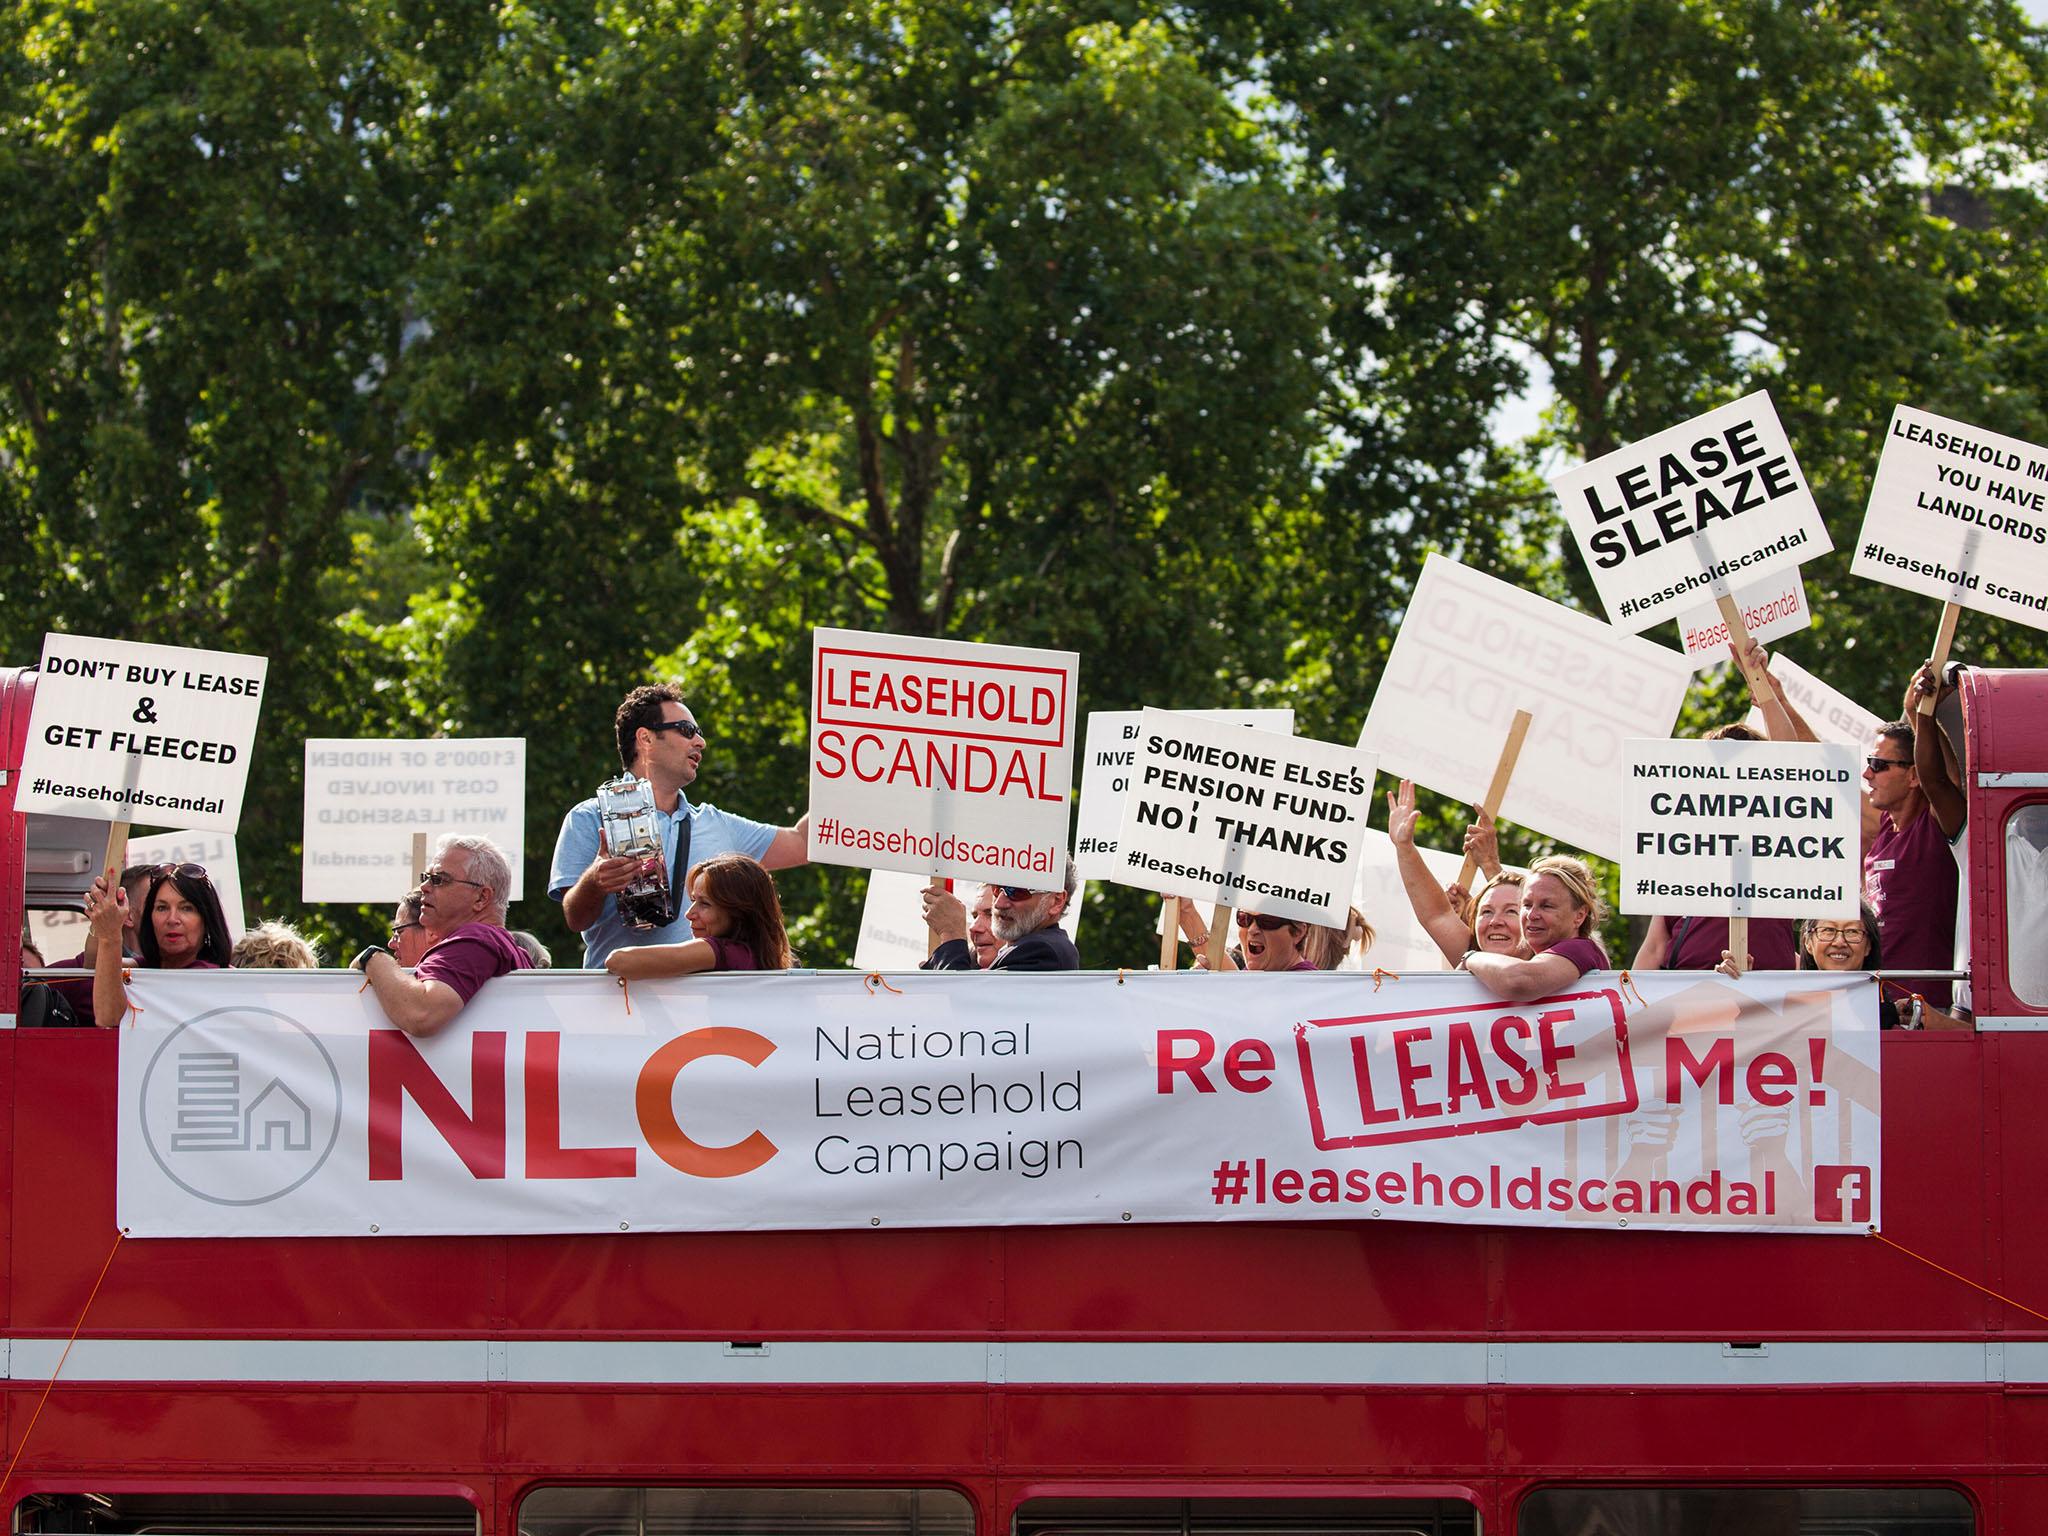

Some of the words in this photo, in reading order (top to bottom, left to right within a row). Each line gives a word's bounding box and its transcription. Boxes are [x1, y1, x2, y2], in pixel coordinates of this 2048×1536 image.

[1894, 420, 2020, 471] LEASEHOLD
[1584, 420, 1766, 524] LEASE
[1938, 465, 1981, 491] YOU
[1987, 481, 2045, 511] HAVE
[1590, 456, 1798, 568] SLEAZE
[1918, 492, 2047, 543] LANDLORDS
[1620, 528, 1807, 617] #leaseholdscandal
[1864, 544, 1979, 590] #leasehold
[1985, 583, 2048, 611] scand
[1687, 586, 1800, 654] #leaseldscandal
[126, 666, 176, 686] BUY
[183, 672, 259, 696] LEASE
[828, 668, 1055, 725] LEASEHOLD
[133, 697, 157, 724] &
[45, 725, 102, 748] GET
[110, 732, 236, 764] FLEECED
[816, 730, 1063, 802] SCANDAL
[1148, 736, 1276, 777] SOMEONE
[33, 779, 224, 813] #leaseholdscandal
[1144, 766, 1264, 807] PENSION
[1634, 765, 1730, 779] NATIONAL
[1737, 768, 1849, 782] LEASEHOLD
[1651, 793, 1832, 819] CAMPAIGN
[818, 819, 1054, 872] #leaseholdscandal
[1216, 817, 1347, 863] THANKS
[1637, 833, 1739, 857] FIGHT
[1752, 836, 1844, 858] BACK
[1128, 851, 1330, 907] #leaseholdscandal
[1637, 880, 1842, 900] #leaseholdscandal
[816, 1023, 1029, 1061] National
[1157, 1030, 1275, 1094] Re
[1350, 1009, 1585, 1124] LEASE
[1664, 1037, 1826, 1107] Me!
[368, 1027, 779, 1181] NLC
[816, 1070, 1081, 1117] Leasehold
[815, 1131, 1082, 1180] Campaign
[1211, 1159, 1775, 1215] #leaseholdscandal
